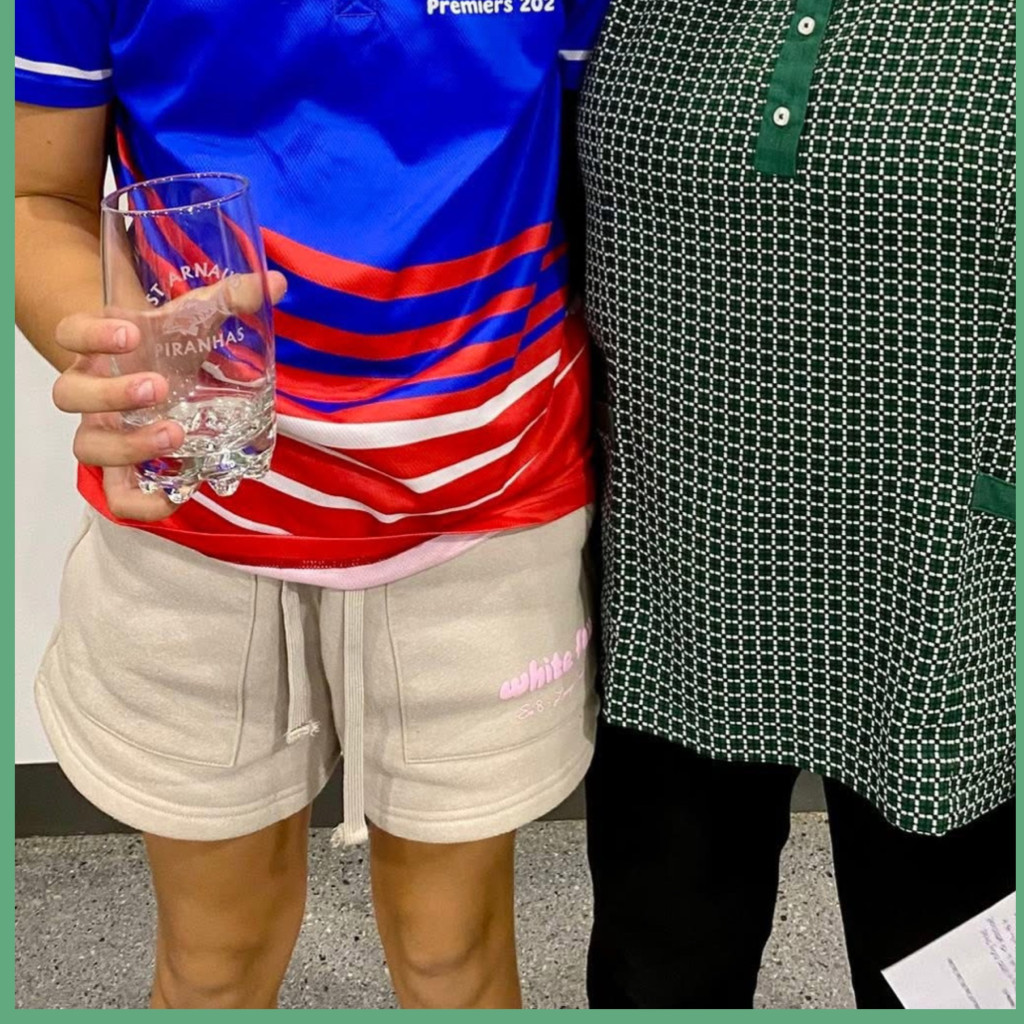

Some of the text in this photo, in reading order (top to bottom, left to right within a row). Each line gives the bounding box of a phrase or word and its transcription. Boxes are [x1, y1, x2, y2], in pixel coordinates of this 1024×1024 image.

[145, 283, 167, 307] ST
[154, 327, 246, 357] PIRANHAS
[499, 650, 574, 701] white
